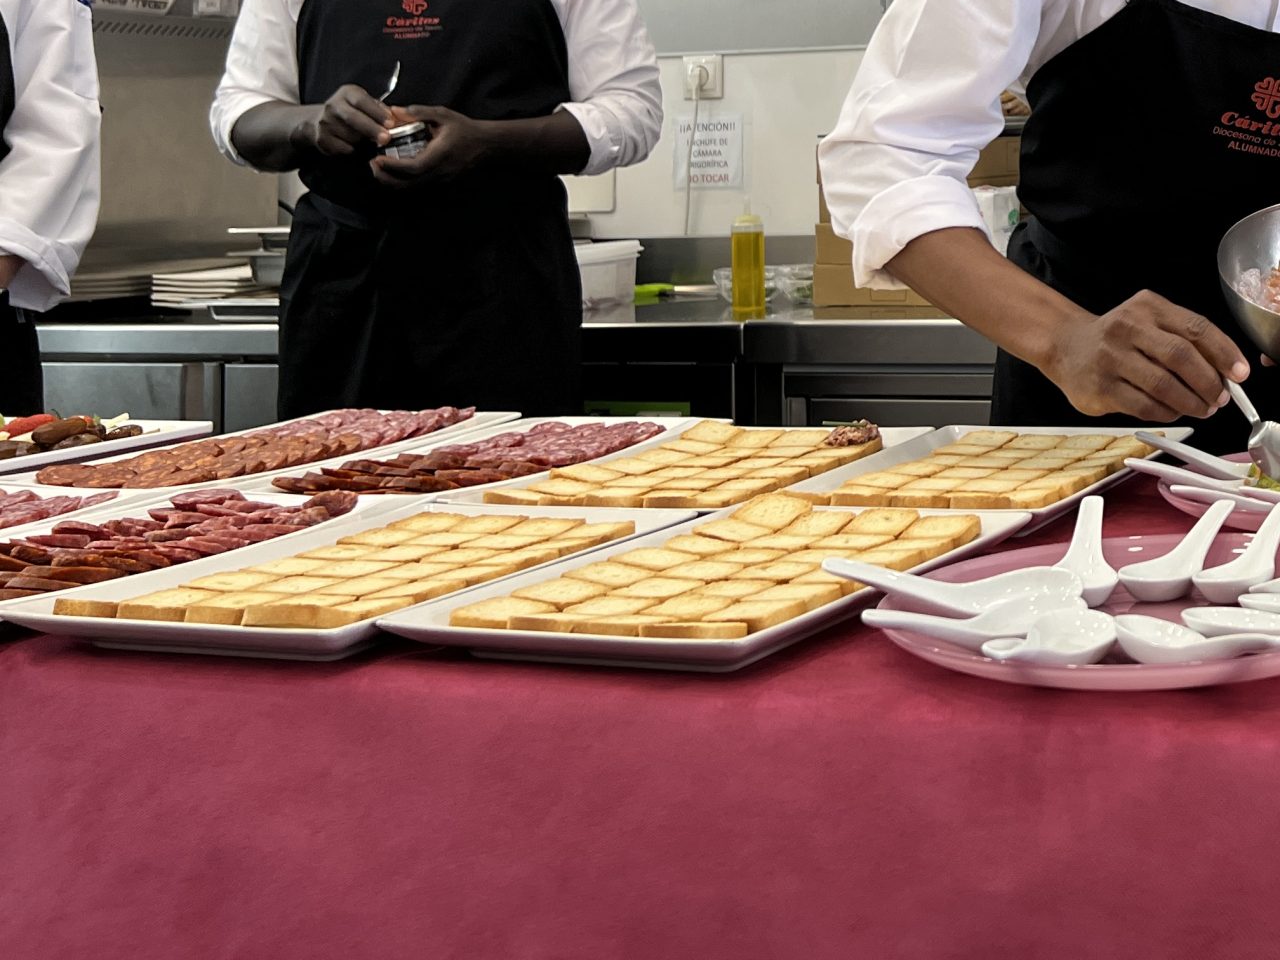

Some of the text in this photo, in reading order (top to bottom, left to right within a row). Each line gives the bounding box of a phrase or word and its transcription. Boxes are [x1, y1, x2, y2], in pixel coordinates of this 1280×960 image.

[1212, 125, 1262, 144] Diocesana
[1263, 138, 1277, 146] de
[692, 149, 722, 158] CÁMARA
[700, 173, 729, 184] TOCAR
